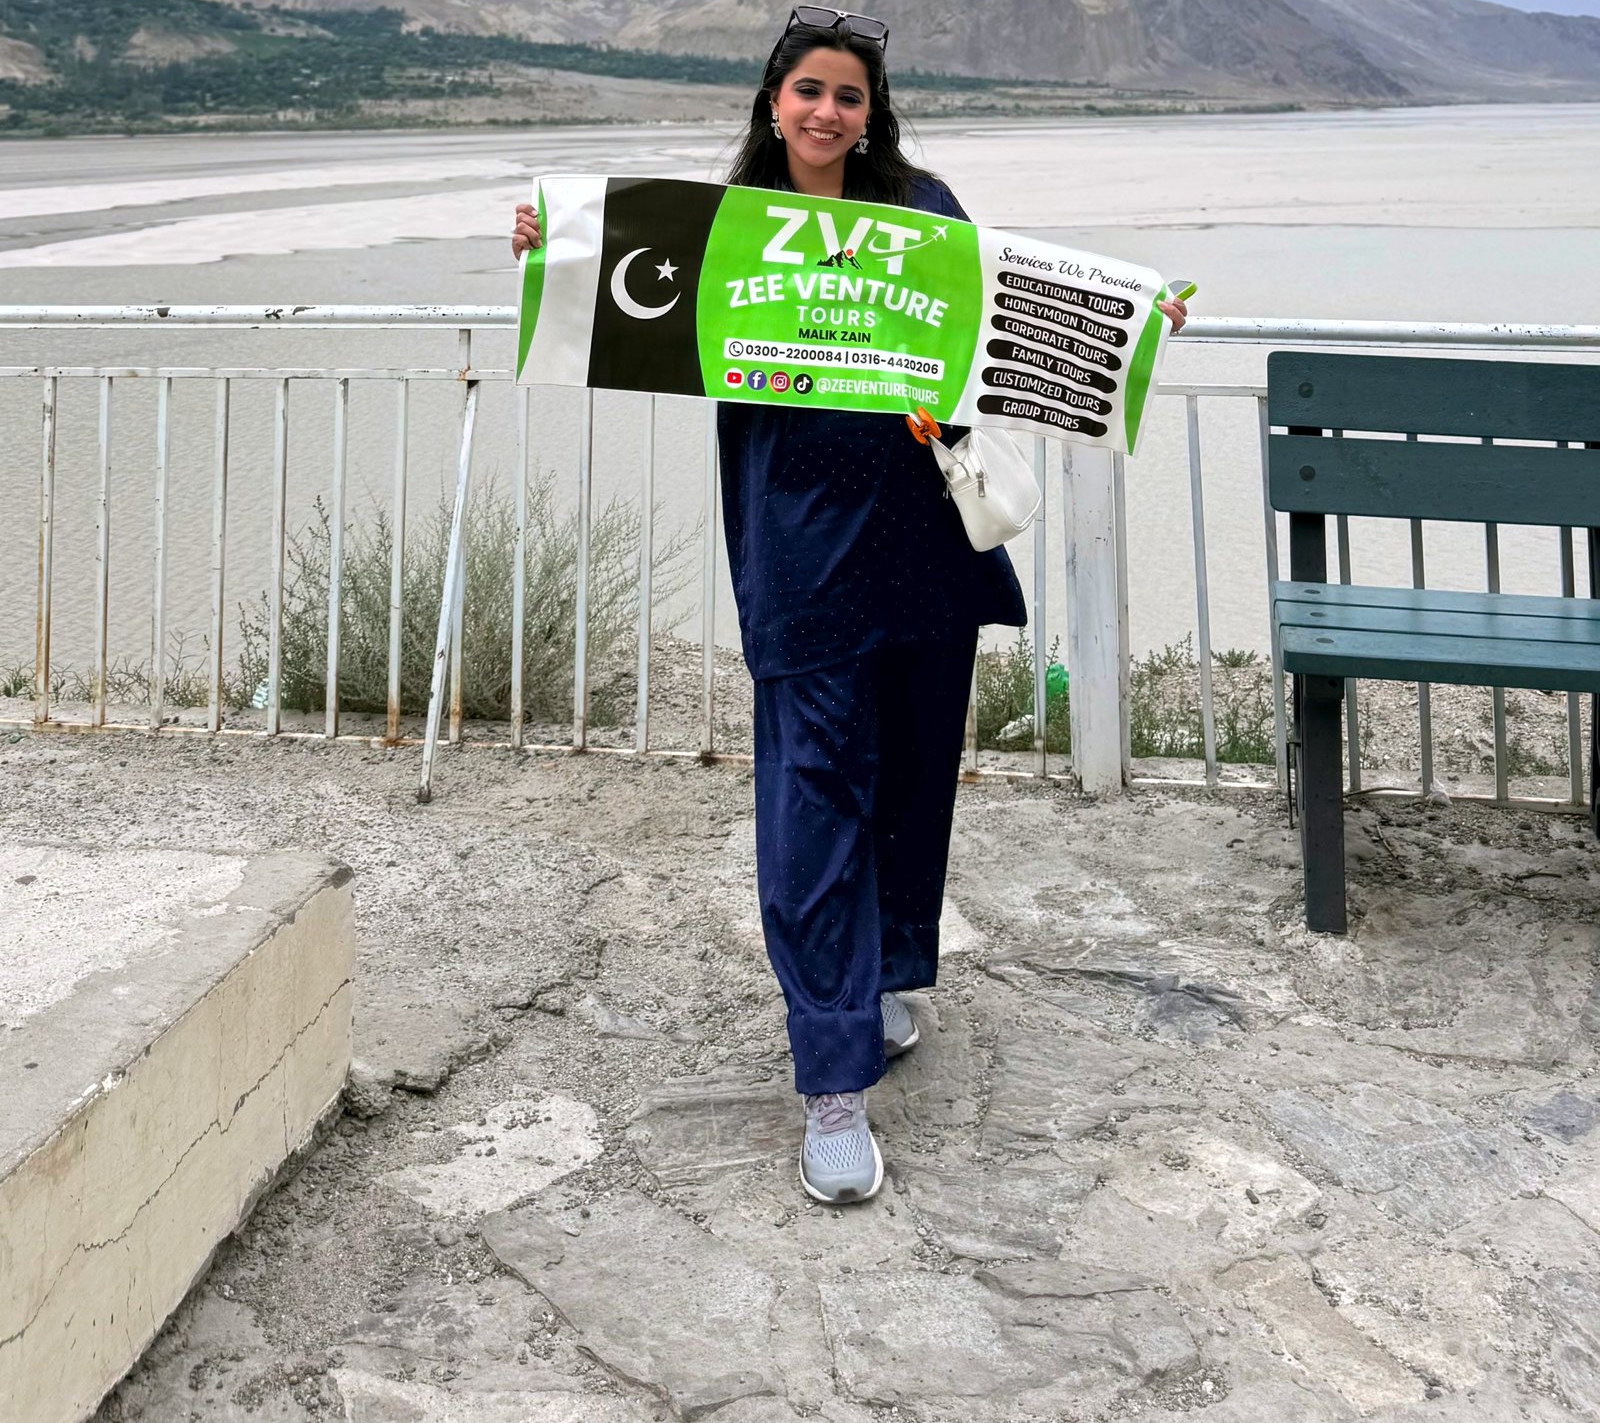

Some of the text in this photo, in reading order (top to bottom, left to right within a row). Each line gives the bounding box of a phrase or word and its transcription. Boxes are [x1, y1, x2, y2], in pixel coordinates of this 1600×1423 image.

[762, 206, 921, 275] ZVT
[999, 248, 1142, 292] Services We Provide
[726, 273, 949, 328] ZEE VENTURE
[1006, 276, 1125, 316] EDUCATIONAL TOURS
[797, 306, 876, 327] TOURS
[798, 328, 872, 343] MALIK ZAIN
[1005, 297, 1117, 343] HONEYMOON TOURS
[746, 345, 842, 362] 0300-2200084
[851, 353, 939, 375] 0316-4420206
[1005, 320, 1108, 364] CORPORATE TOURS
[1012, 347, 1091, 383] FAMILY TOURS
[816, 378, 939, 405] @ZEEVENTURETOURS
[993, 372, 1100, 412] CUSTOMIZED TOURS
[1003, 401, 1079, 429] GROUP TOURS
